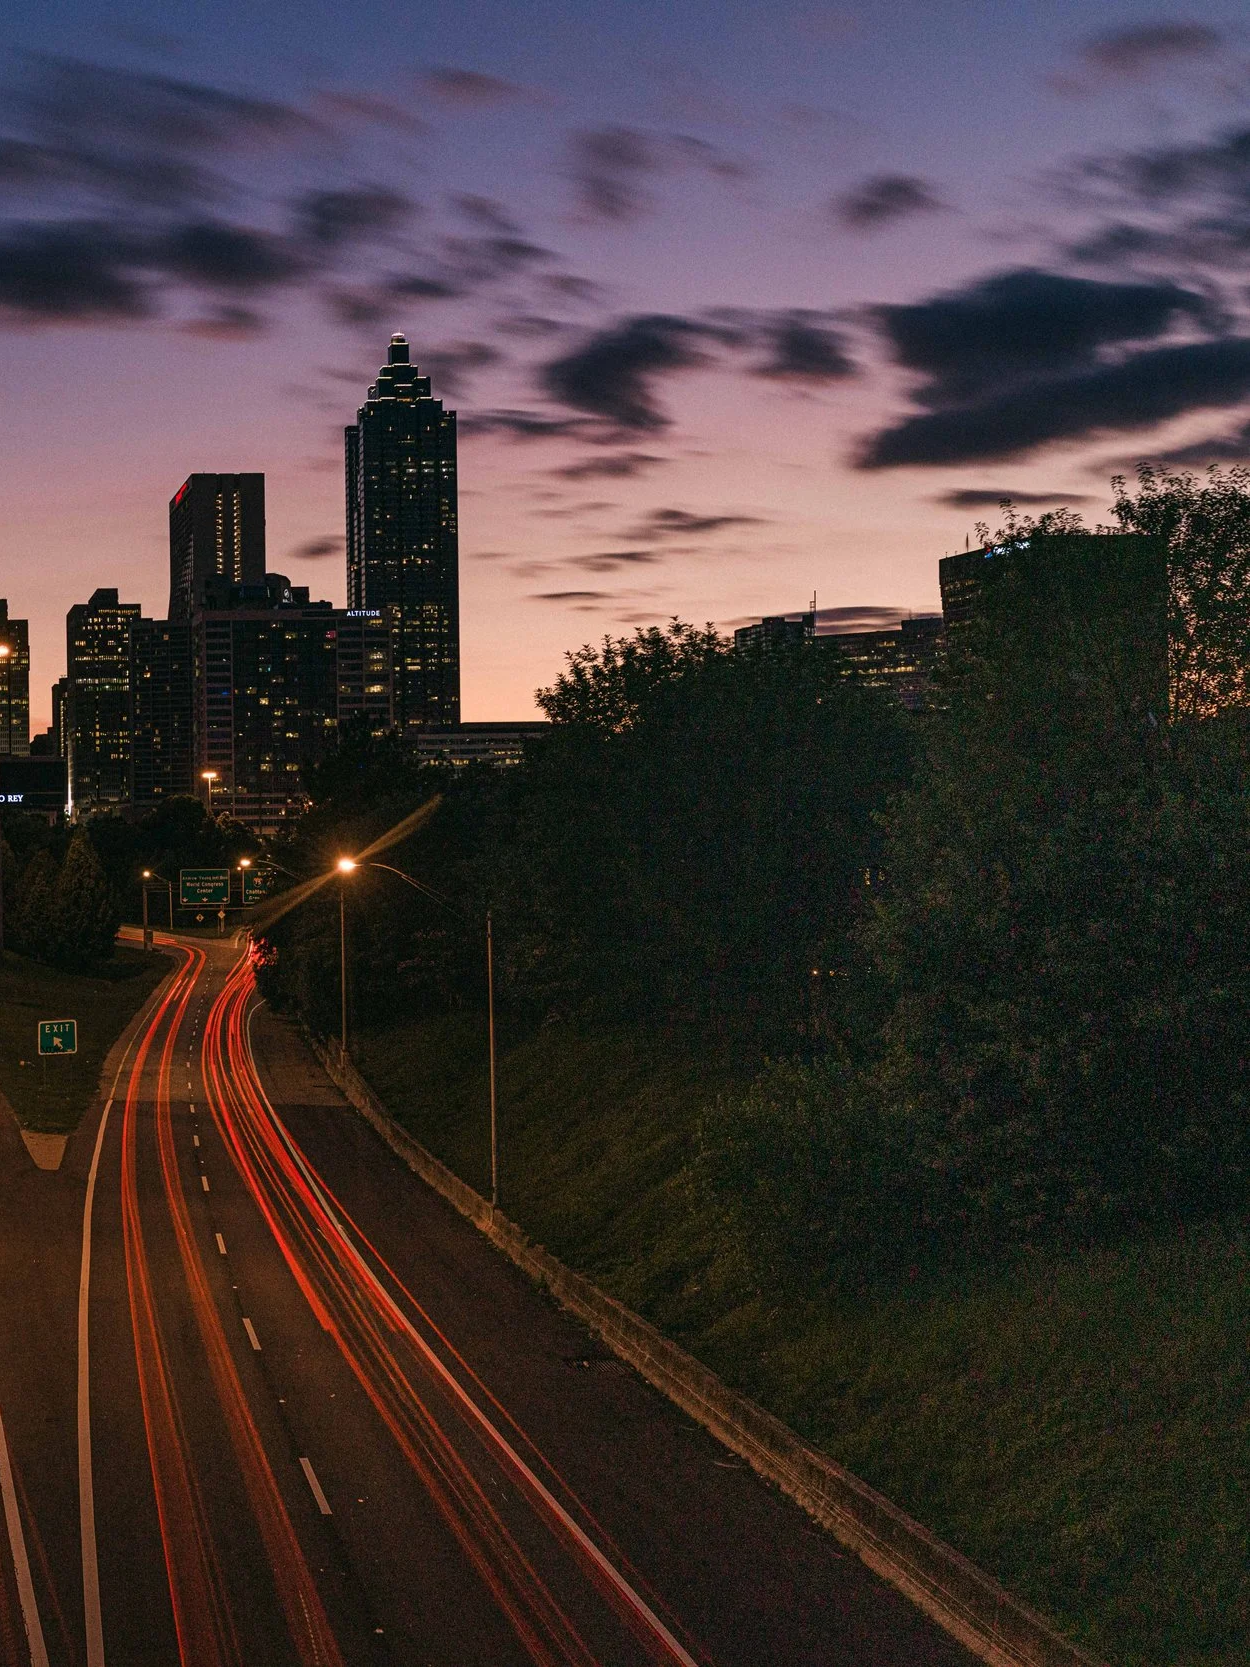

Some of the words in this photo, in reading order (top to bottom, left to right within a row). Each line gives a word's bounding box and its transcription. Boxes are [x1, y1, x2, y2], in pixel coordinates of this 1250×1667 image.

[7, 794, 24, 803] REY
[201, 881, 224, 889] Congress
[45, 1023, 70, 1033] EXIT
